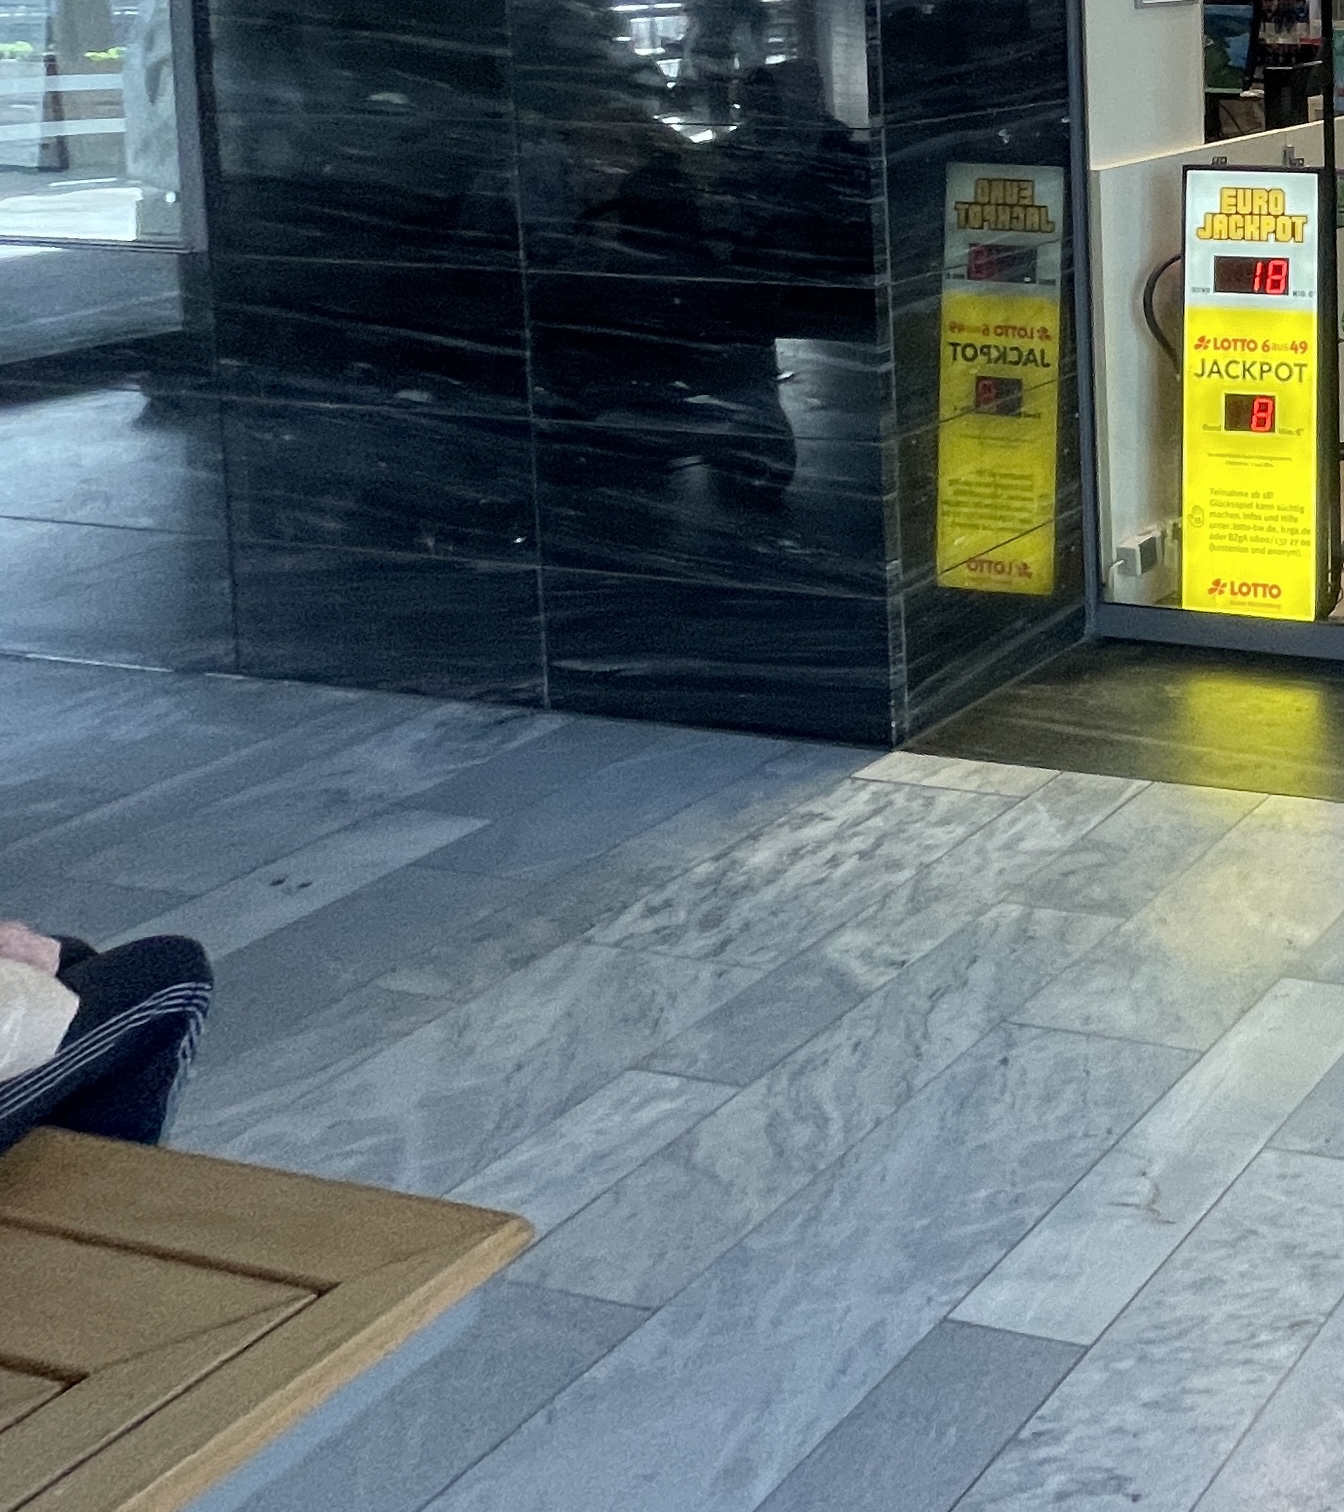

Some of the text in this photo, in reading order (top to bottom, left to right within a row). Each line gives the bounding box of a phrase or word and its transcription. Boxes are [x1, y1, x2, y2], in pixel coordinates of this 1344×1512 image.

[1220, 187, 1285, 215] EURO
[1196, 213, 1308, 243] JACKPOT
[1252, 259, 1287, 295] 18
[1213, 338, 1257, 352] LOTTO
[1194, 359, 1308, 383] JACKPOT
[1251, 397, 1274, 432] 8
[1230, 581, 1281, 599] LOTTO
